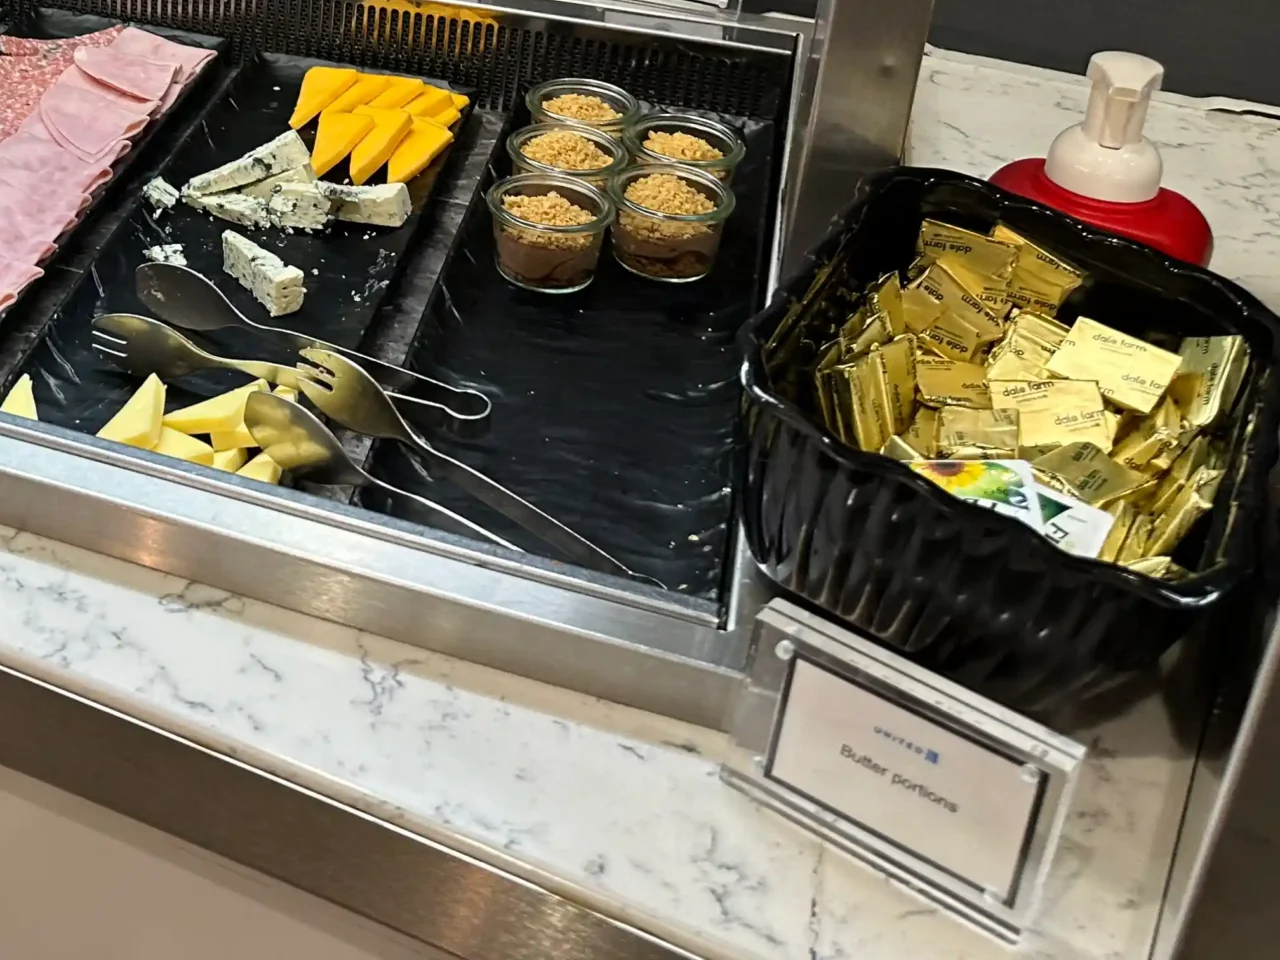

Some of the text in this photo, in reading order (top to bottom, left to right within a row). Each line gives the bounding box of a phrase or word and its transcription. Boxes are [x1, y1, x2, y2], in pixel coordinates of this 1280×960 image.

[961, 294, 983, 314] farm
[946, 340, 968, 353] dale
[1092, 333, 1117, 344] dale
[1120, 339, 1148, 352] farm
[1121, 373, 1147, 385] dale
[1002, 381, 1055, 397] dale farm
[1054, 409, 1105, 425] dale farm
[873, 725, 924, 755] UNITED
[839, 743, 959, 814] Butter portions
